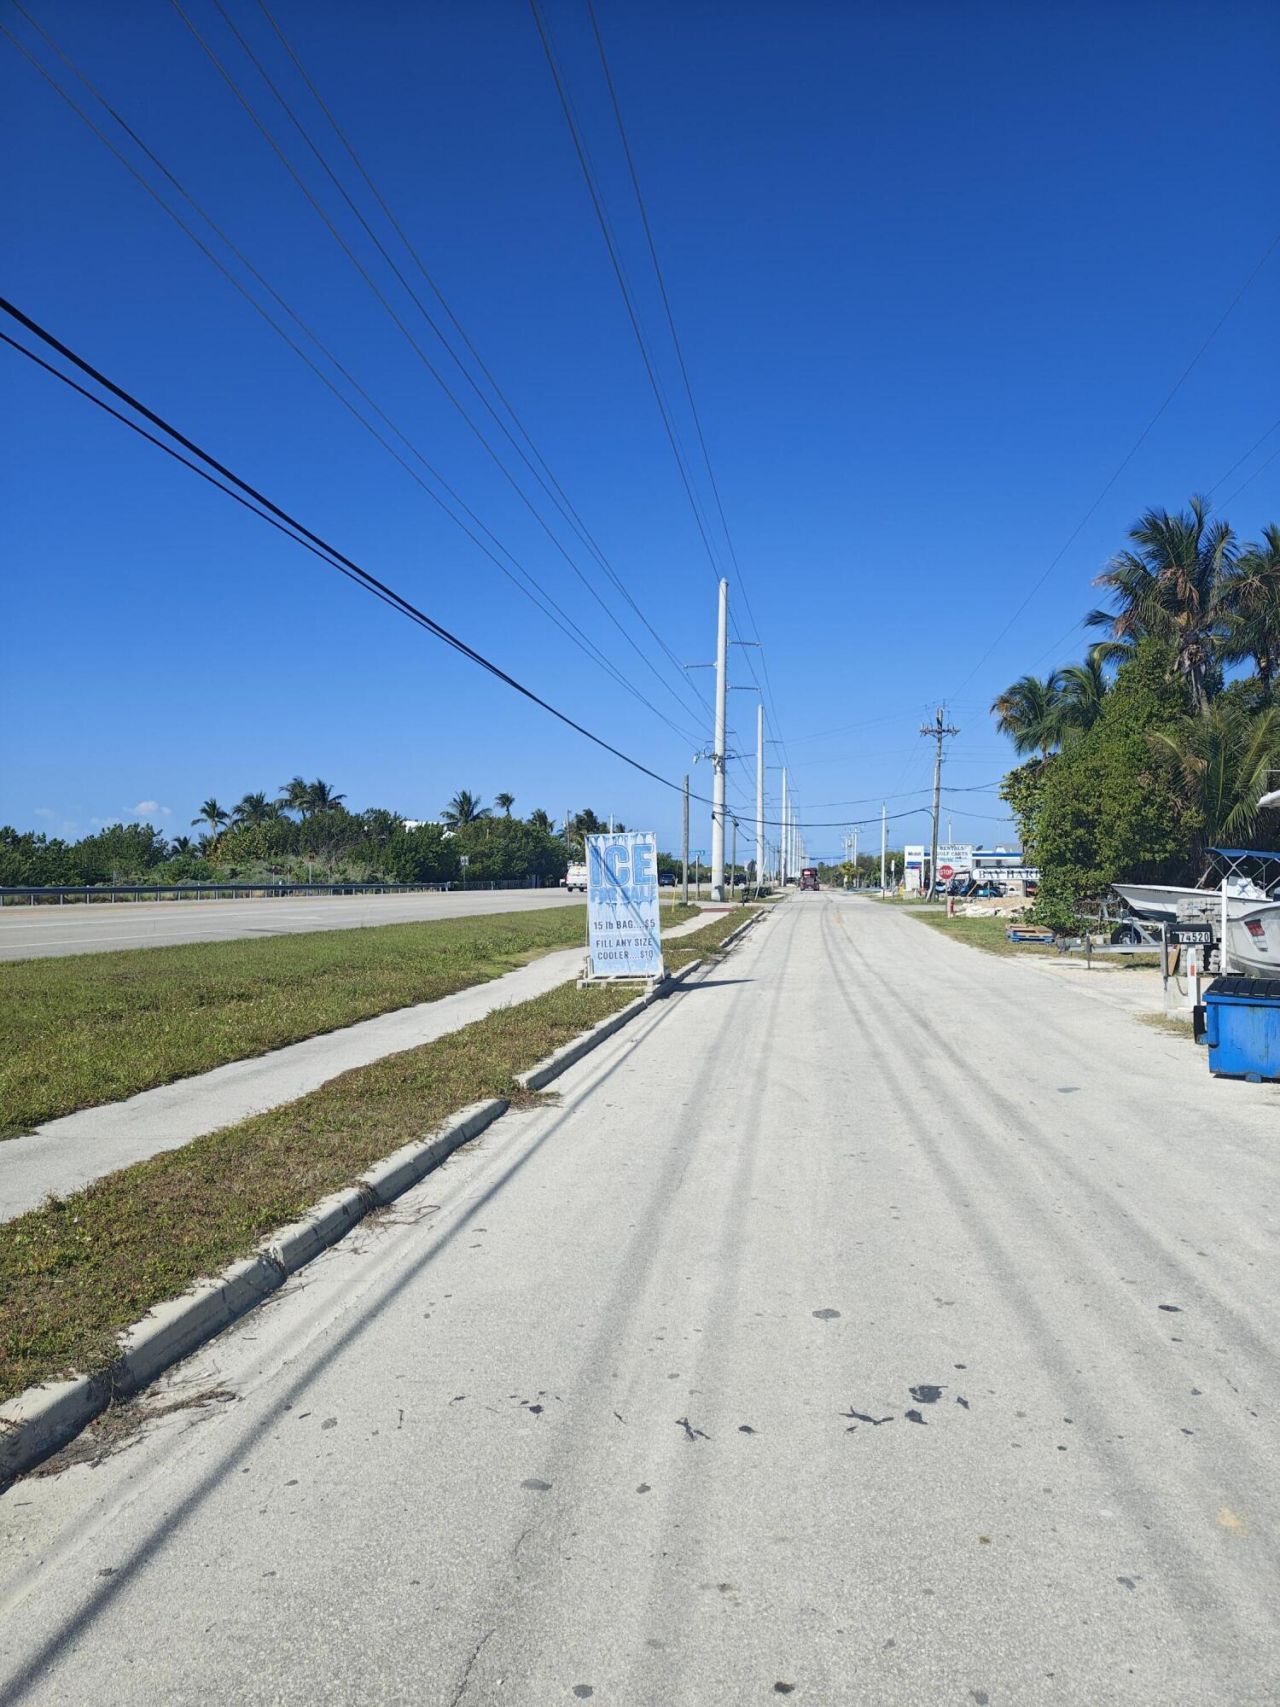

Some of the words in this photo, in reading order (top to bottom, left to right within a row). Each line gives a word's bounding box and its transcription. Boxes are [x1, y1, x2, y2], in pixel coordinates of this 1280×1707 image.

[591, 843, 657, 887] ICE
[979, 870, 1000, 879] BAY
[594, 921, 603, 930] 15
[596, 939, 613, 948] FILL
[615, 939, 632, 947] ANY
[634, 938, 653, 947] SIZE
